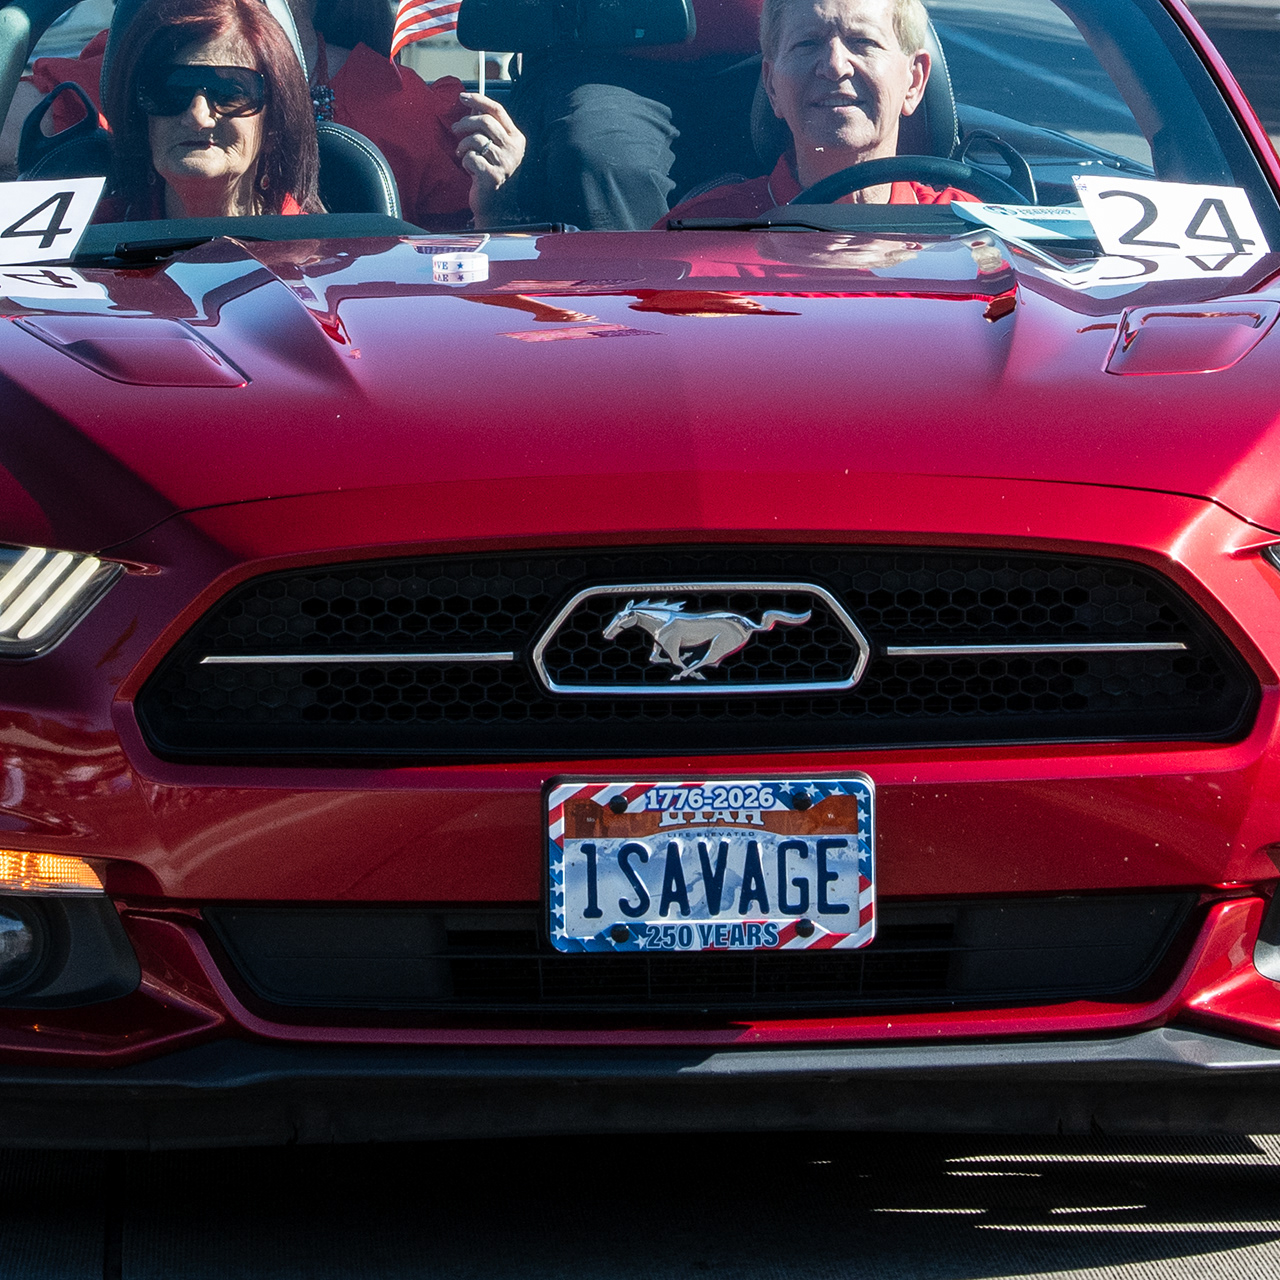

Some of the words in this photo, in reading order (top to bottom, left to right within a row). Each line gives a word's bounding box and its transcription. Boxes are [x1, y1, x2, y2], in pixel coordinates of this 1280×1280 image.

[1098, 189, 1256, 254] 24
[646, 787, 775, 810] 1776-2026
[646, 923, 693, 948] 250
[701, 923, 779, 948] YEARS
